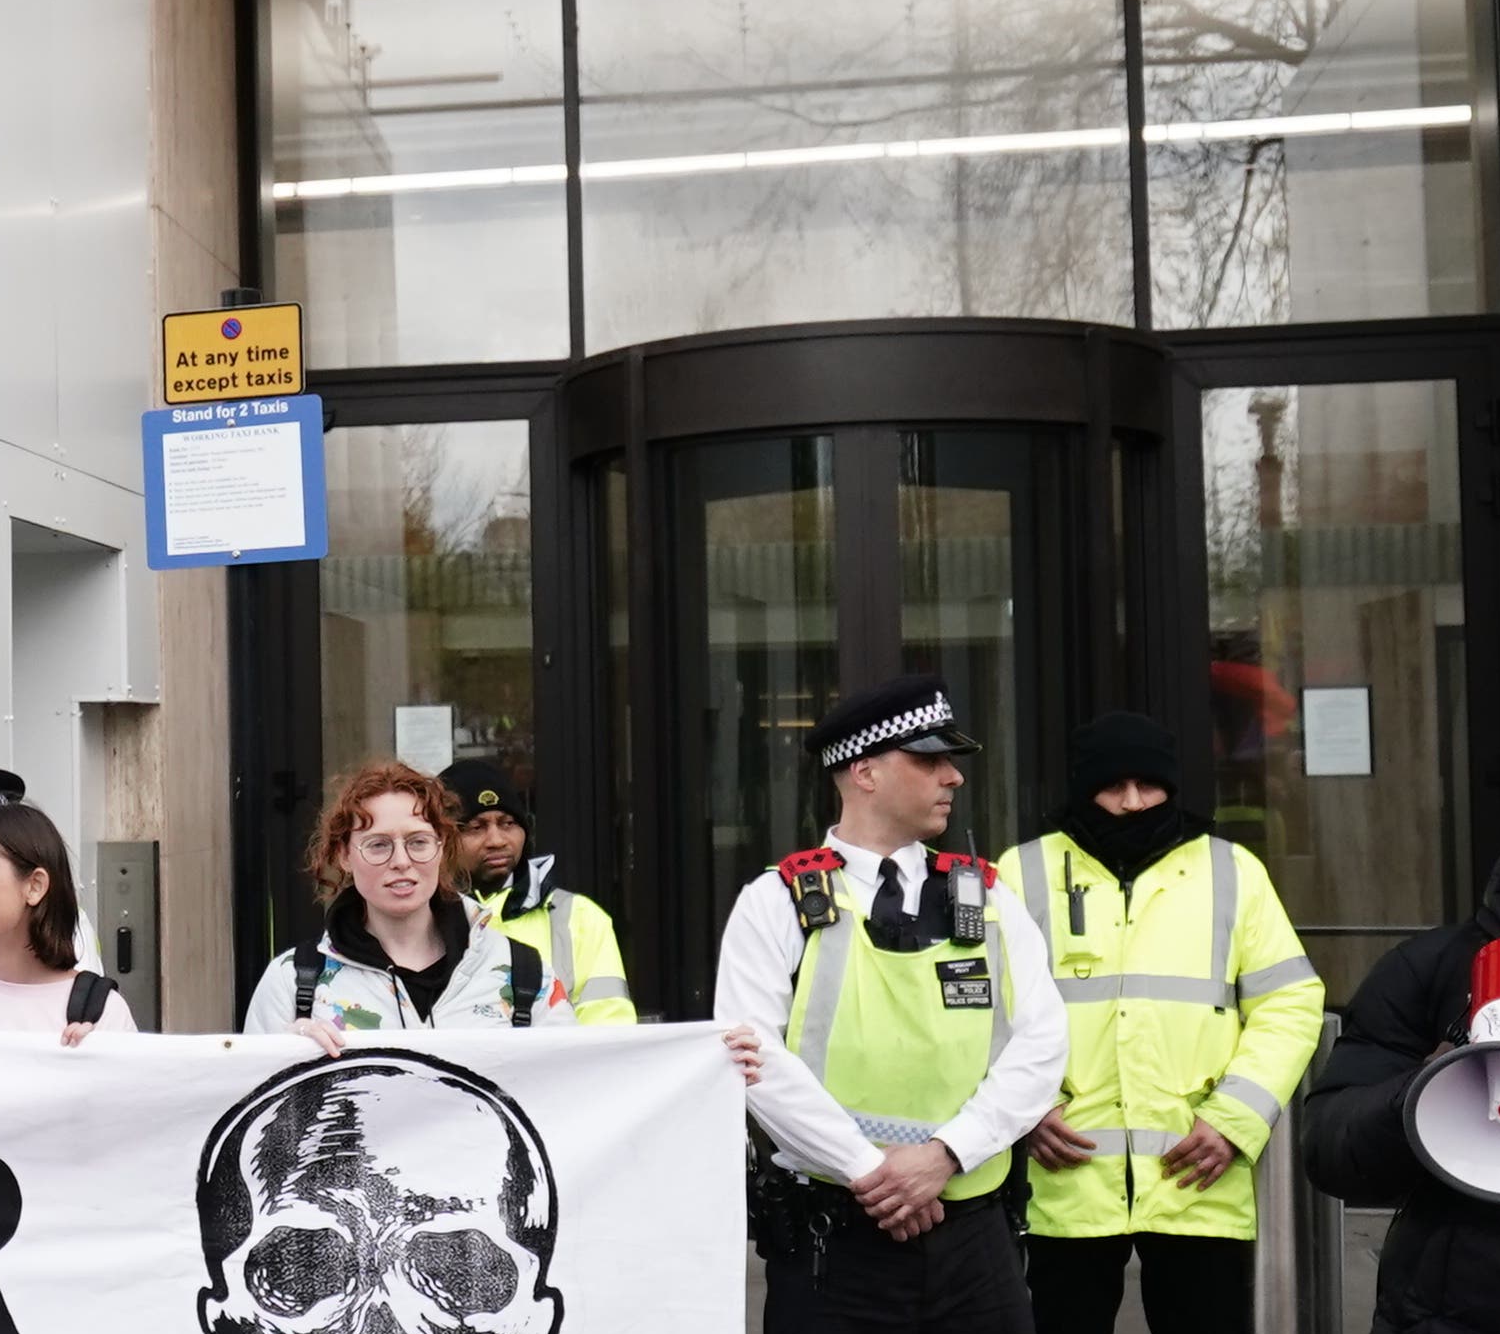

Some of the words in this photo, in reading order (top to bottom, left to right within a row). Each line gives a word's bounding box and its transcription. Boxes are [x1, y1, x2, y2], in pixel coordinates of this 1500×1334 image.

[176, 351, 198, 368] At
[205, 351, 239, 367] any
[247, 346, 290, 362] time
[174, 372, 238, 392] except
[246, 369, 293, 387] taxis
[172, 405, 212, 423] Stand
[216, 405, 236, 419] for
[239, 403, 248, 417] 2
[252, 399, 288, 415] Taxis
[183, 433, 228, 442] WORKING
[230, 431, 252, 439] TAXI
[254, 427, 280, 435] RANK
